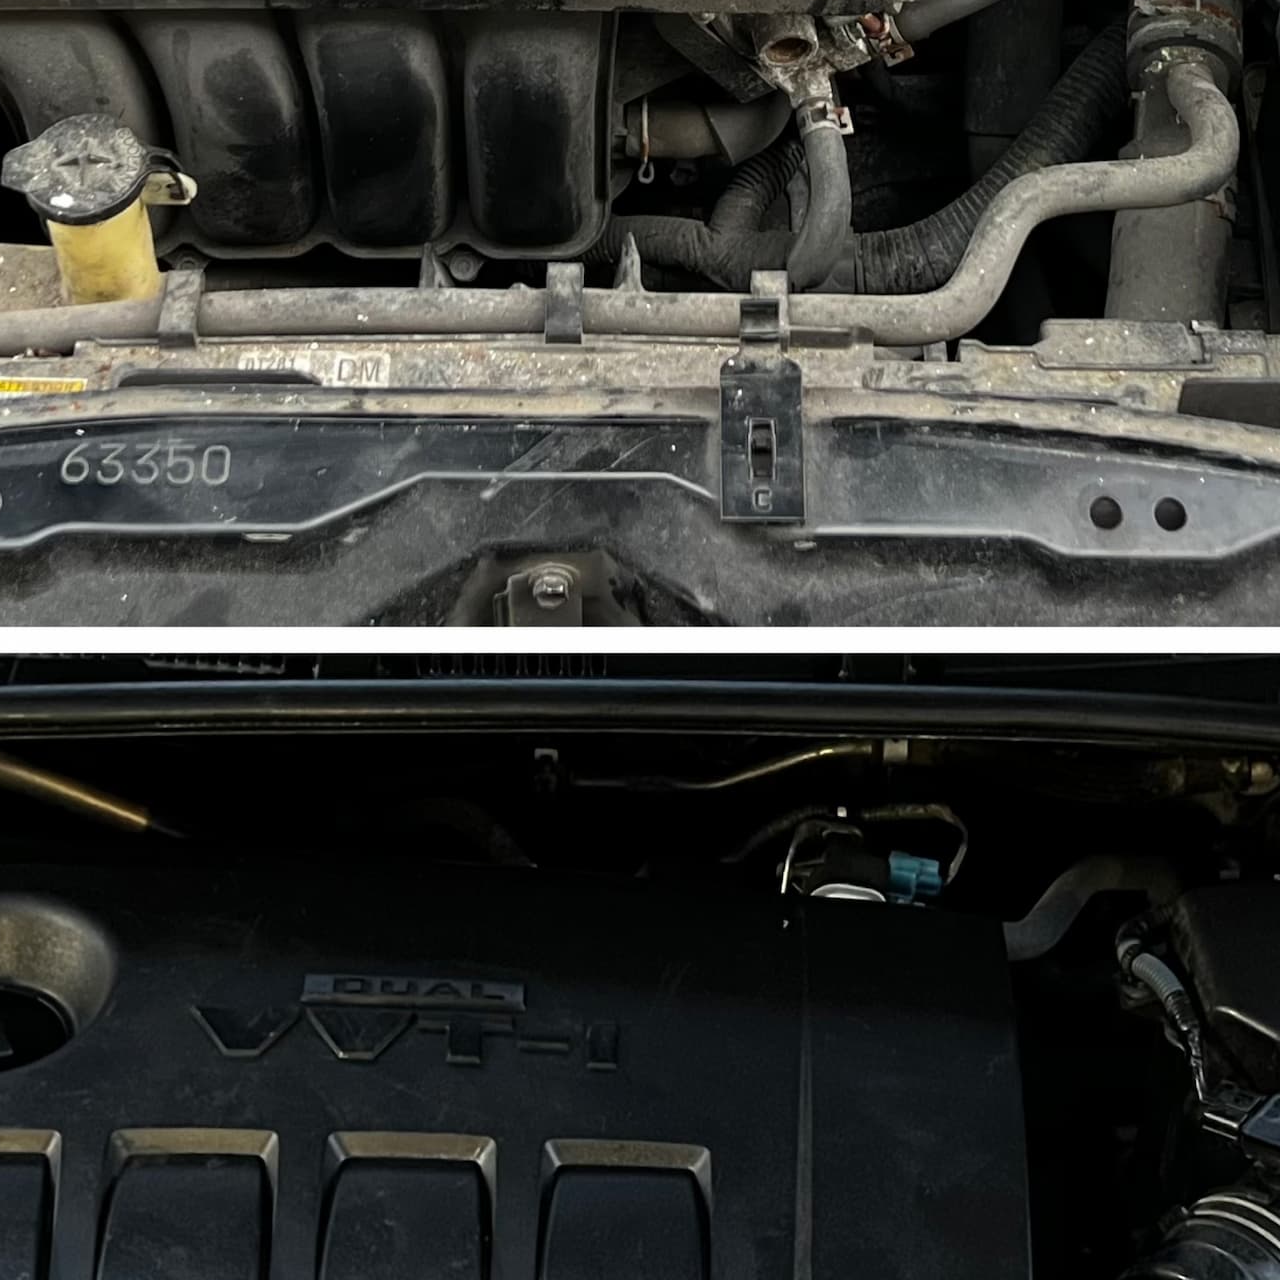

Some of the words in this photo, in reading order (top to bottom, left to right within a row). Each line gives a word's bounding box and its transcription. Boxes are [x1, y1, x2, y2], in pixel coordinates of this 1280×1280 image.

[337, 358, 381, 382] DM
[61, 443, 232, 487] 63350
[332, 977, 508, 1001] DUAL
